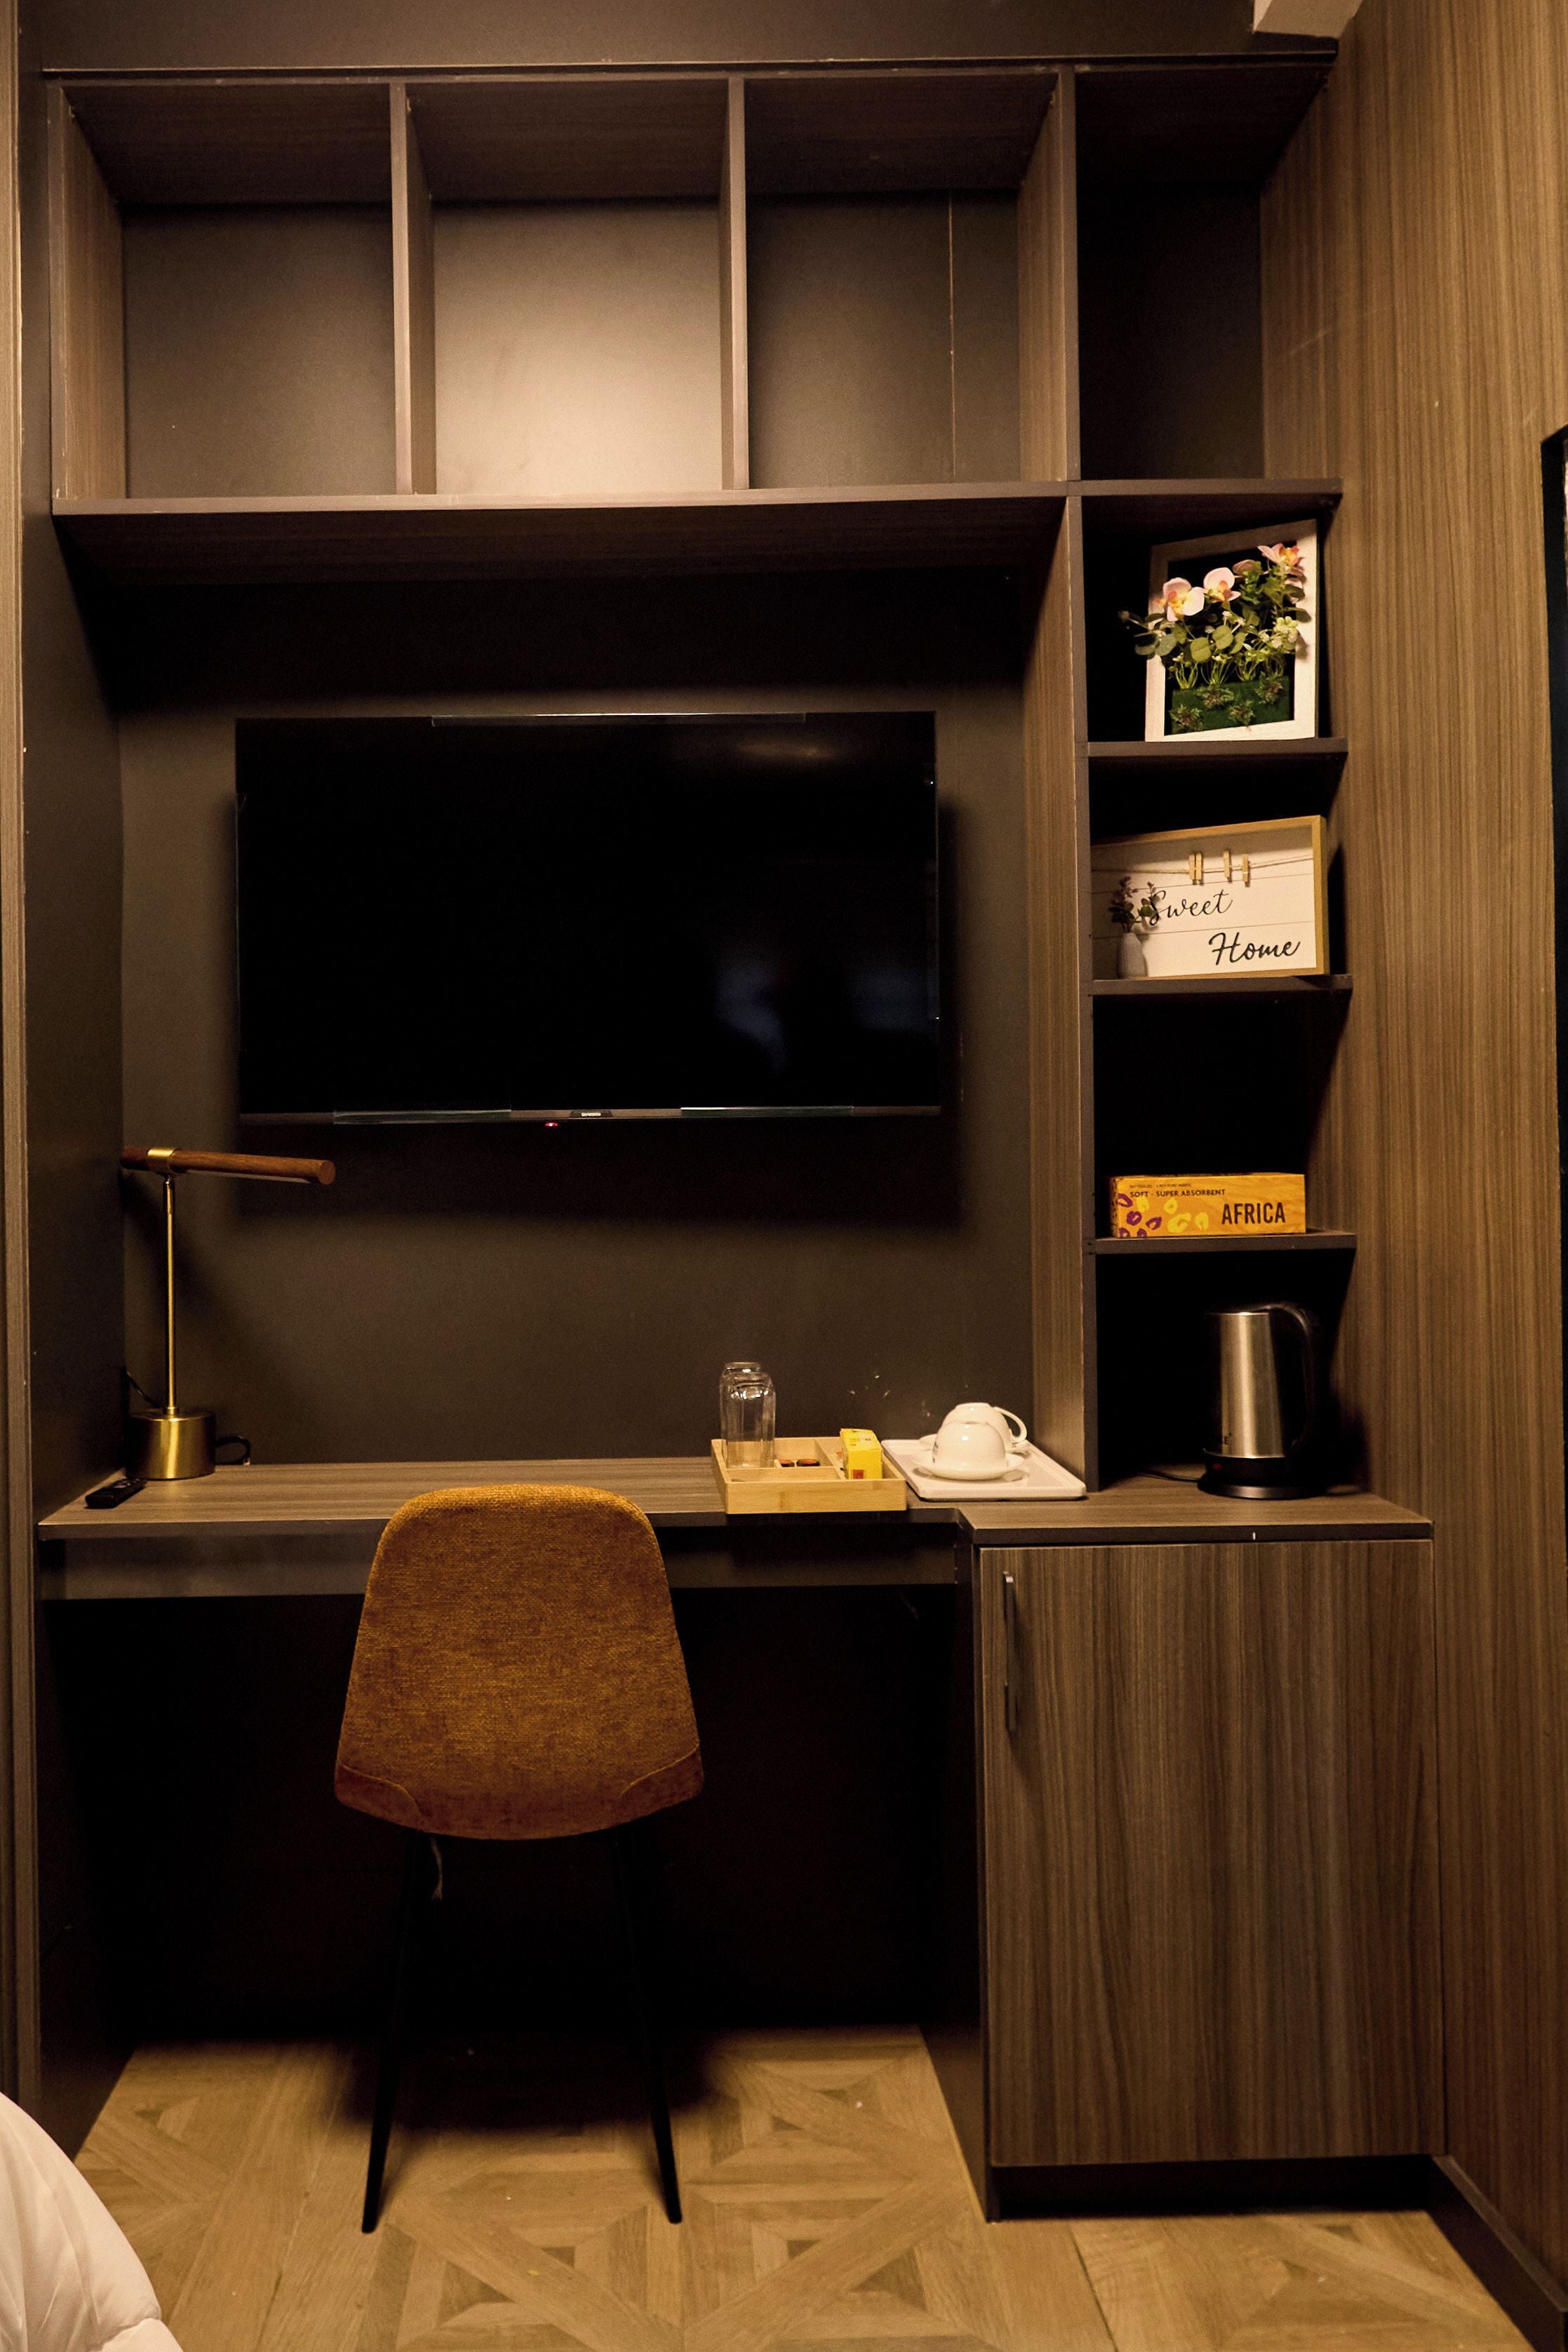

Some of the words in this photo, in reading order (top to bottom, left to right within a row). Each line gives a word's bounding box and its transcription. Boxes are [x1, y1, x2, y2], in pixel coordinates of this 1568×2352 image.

[1148, 888, 1233, 926] Sweet
[1208, 931, 1301, 966] Home
[1221, 1202, 1286, 1225] AFRICA
